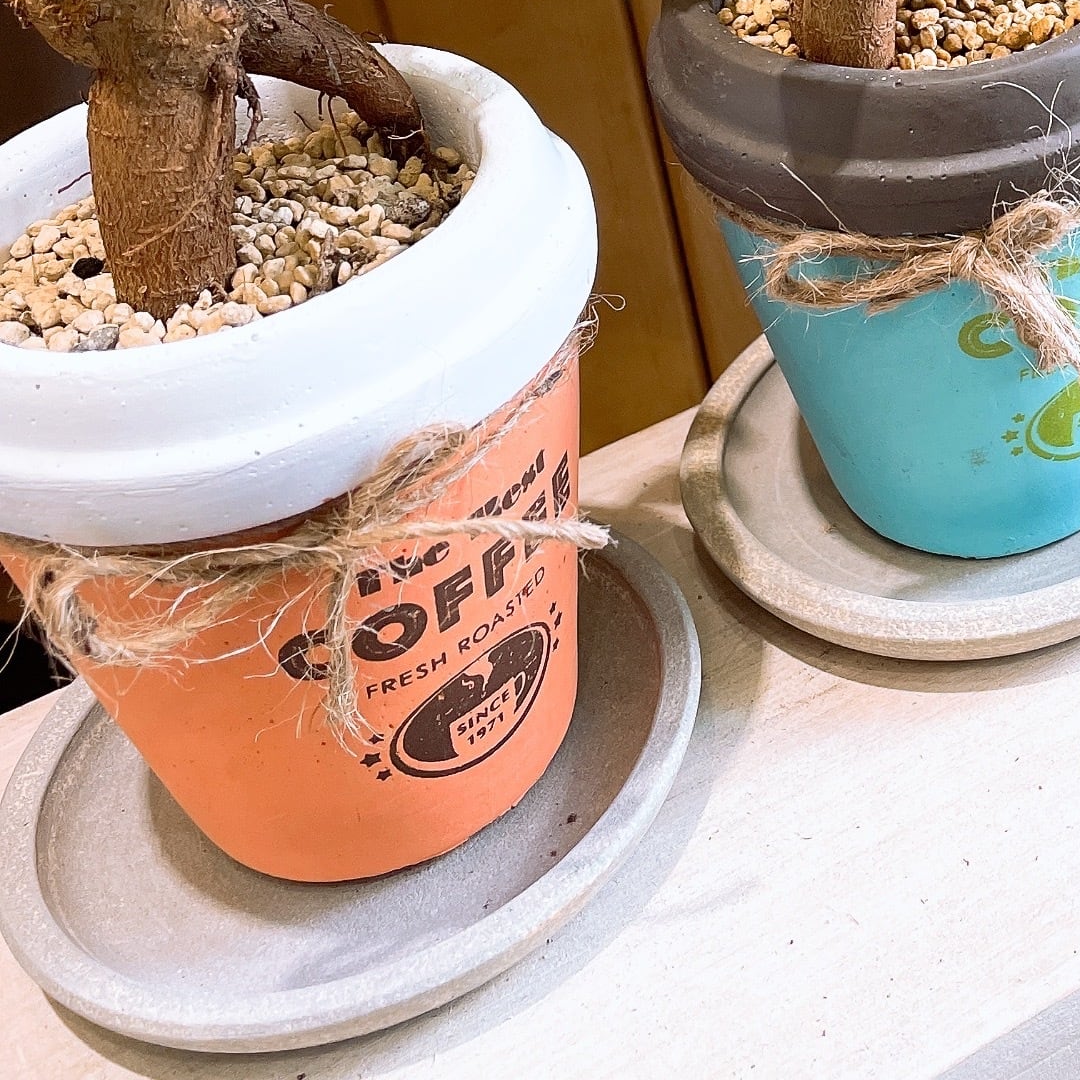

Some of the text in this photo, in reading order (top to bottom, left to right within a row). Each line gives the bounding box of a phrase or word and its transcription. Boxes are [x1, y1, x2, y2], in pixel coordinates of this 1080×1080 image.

[365, 565, 546, 700] FRESH ROASTED
[456, 688, 511, 737] SINCE
[466, 713, 505, 746] 1971
